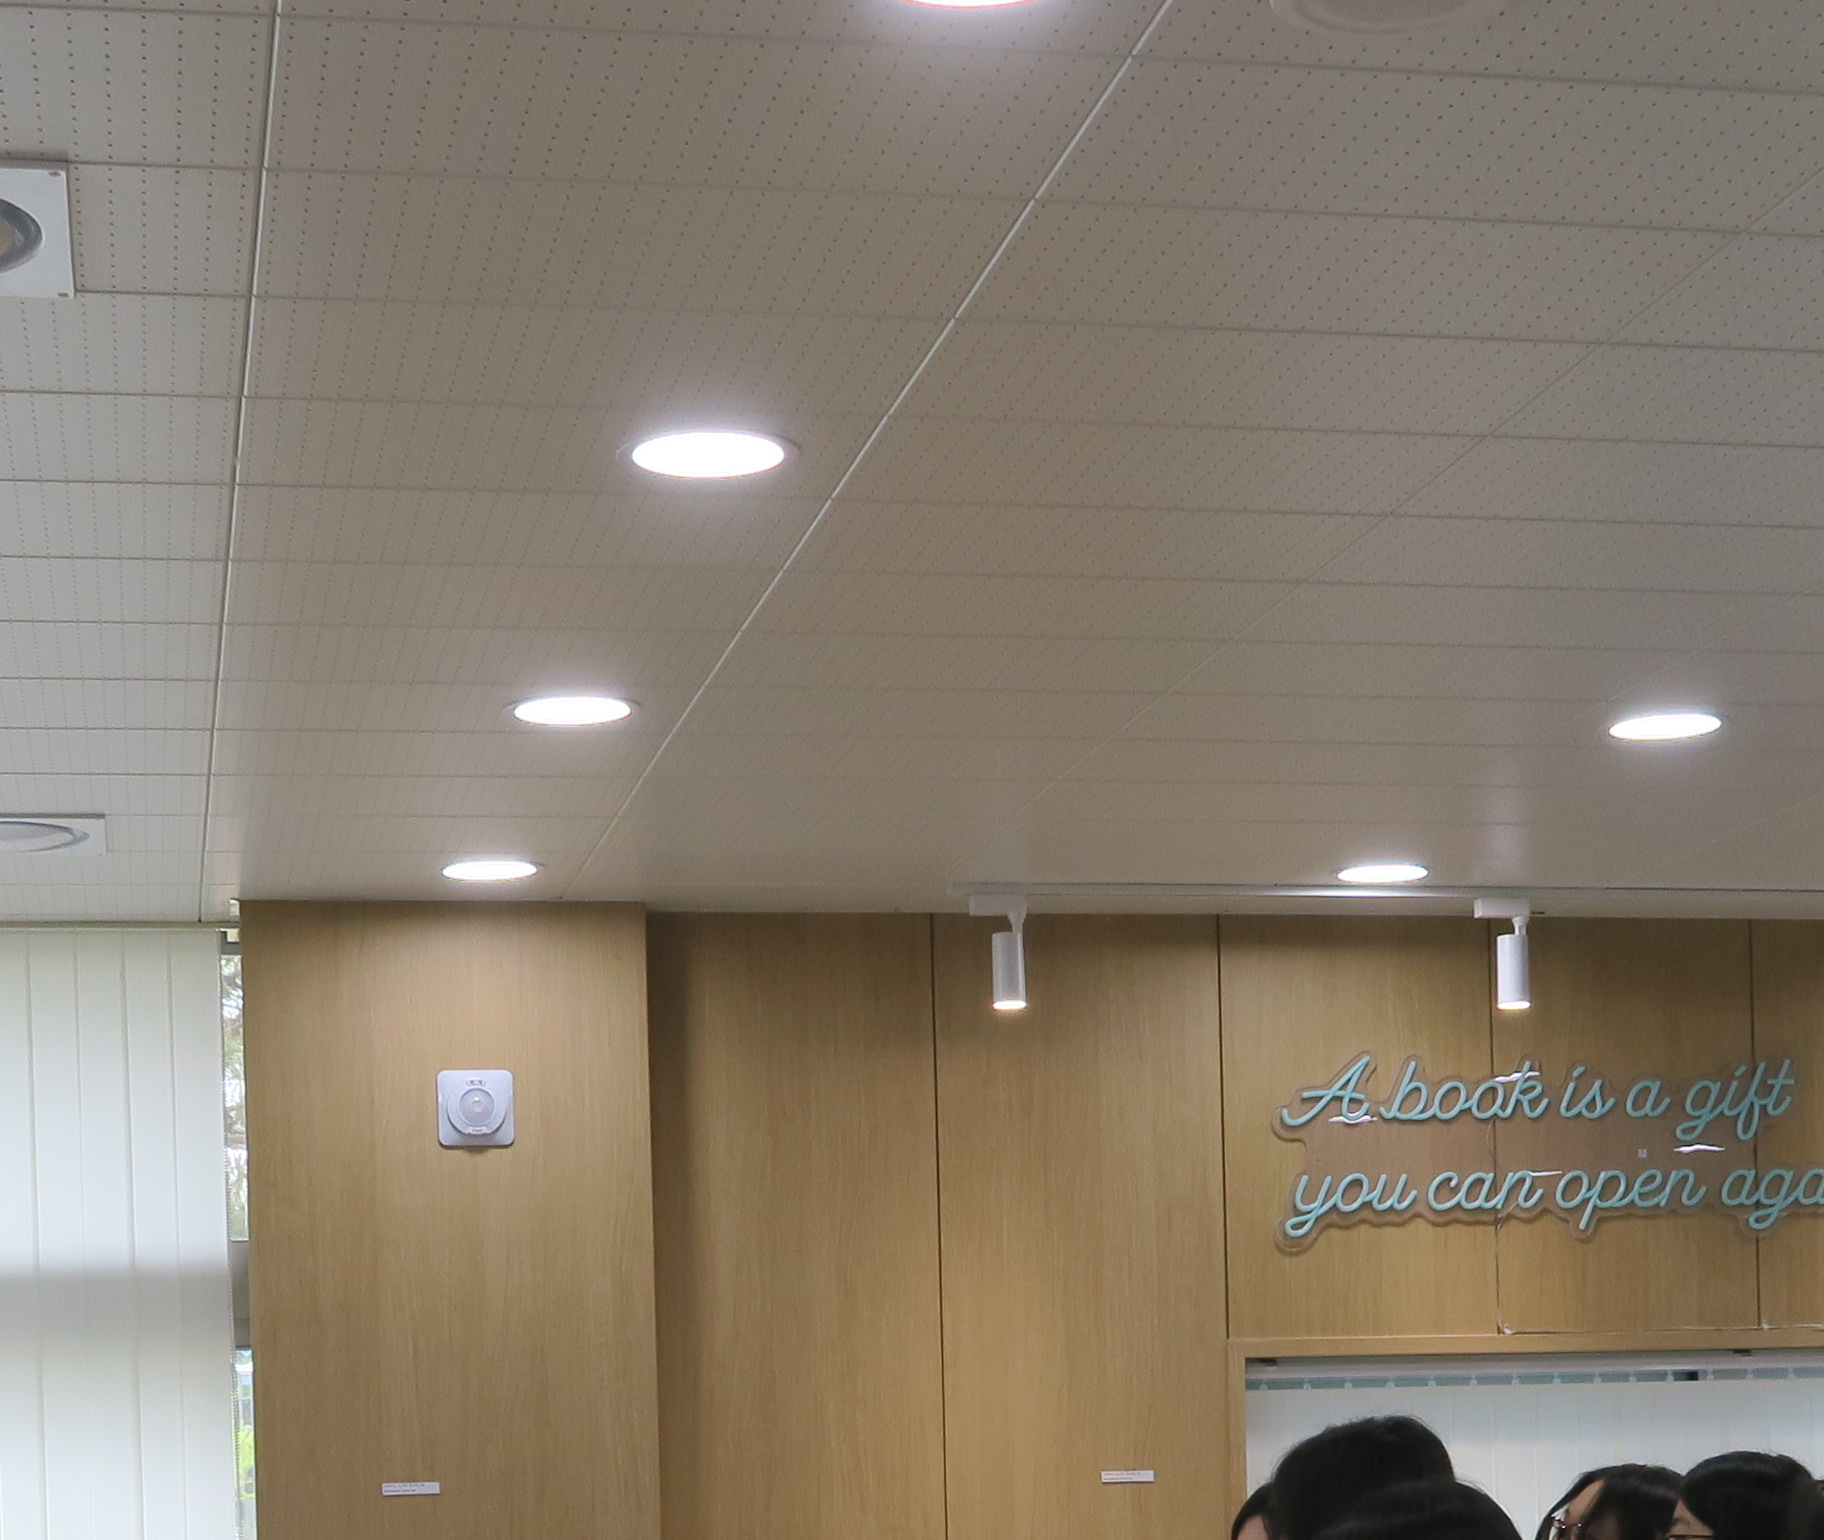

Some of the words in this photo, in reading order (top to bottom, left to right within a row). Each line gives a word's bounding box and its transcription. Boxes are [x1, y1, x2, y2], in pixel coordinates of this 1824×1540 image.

[1281, 1055, 1371, 1127] A
[1379, 1060, 1549, 1121] book
[1559, 1066, 1615, 1120] is
[1625, 1079, 1671, 1118] a
[1676, 1059, 1795, 1141] gift
[1284, 1171, 1419, 1238] you
[1427, 1170, 1545, 1211] can
[1555, 1168, 1708, 1230] open
